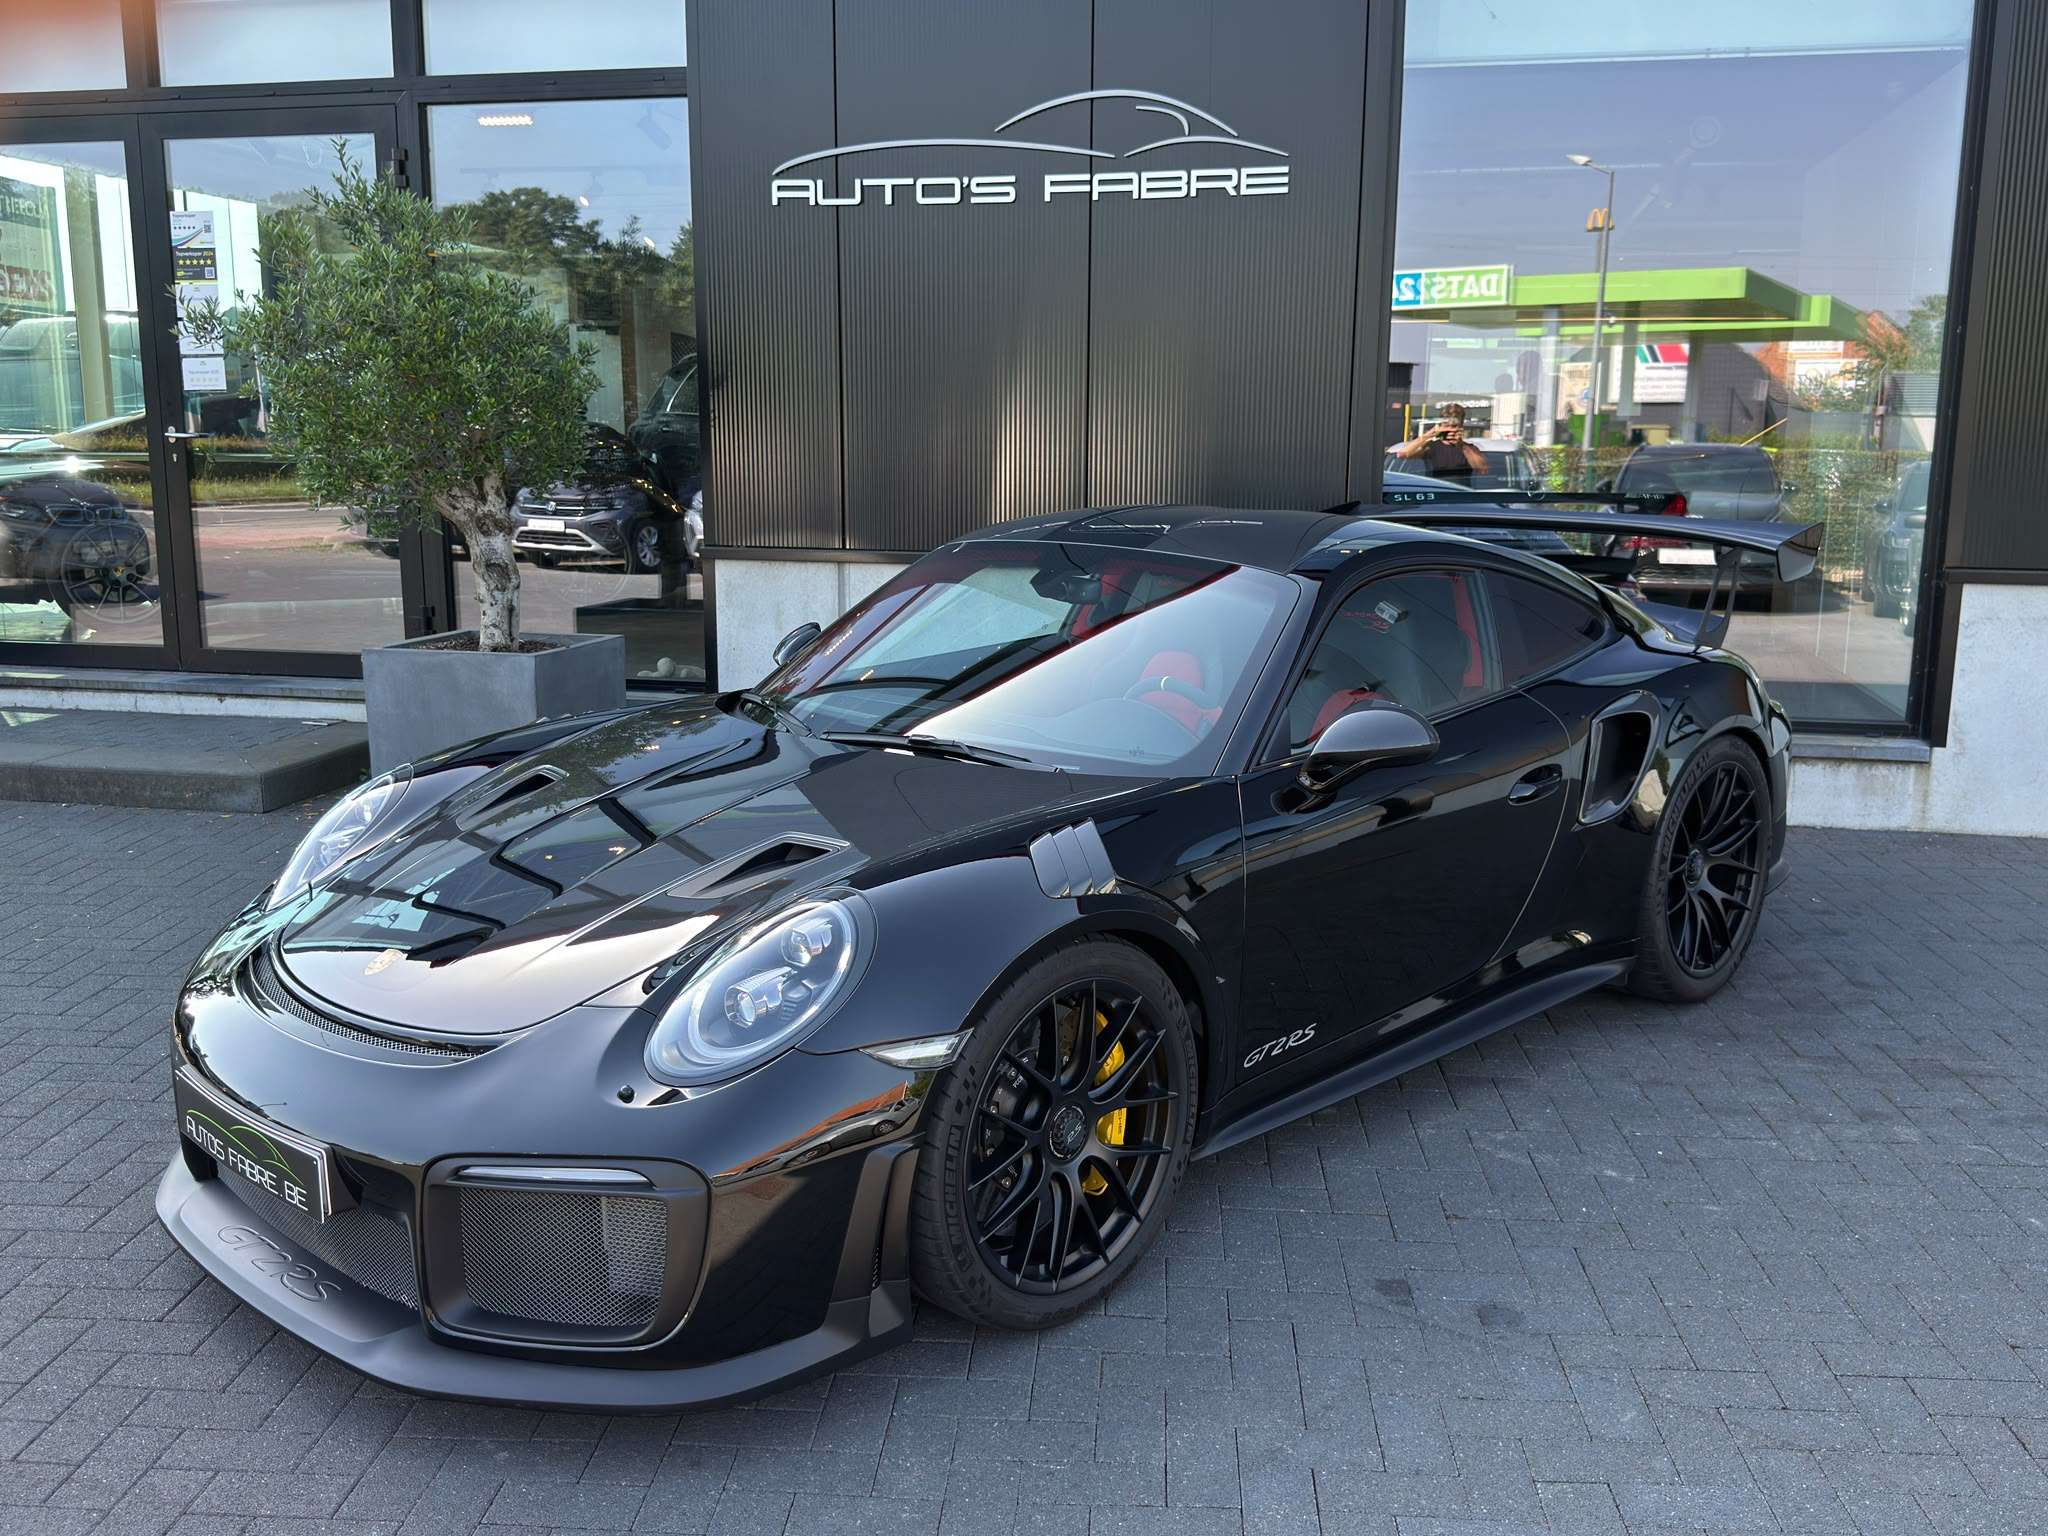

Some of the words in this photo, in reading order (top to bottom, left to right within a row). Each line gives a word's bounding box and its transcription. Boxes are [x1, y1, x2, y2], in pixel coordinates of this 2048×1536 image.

[771, 175, 1016, 206] AUTO'S
[1044, 165, 1289, 202] FABRE
[1394, 494, 1412, 502] SL
[186, 1115, 226, 1161] AUTOS
